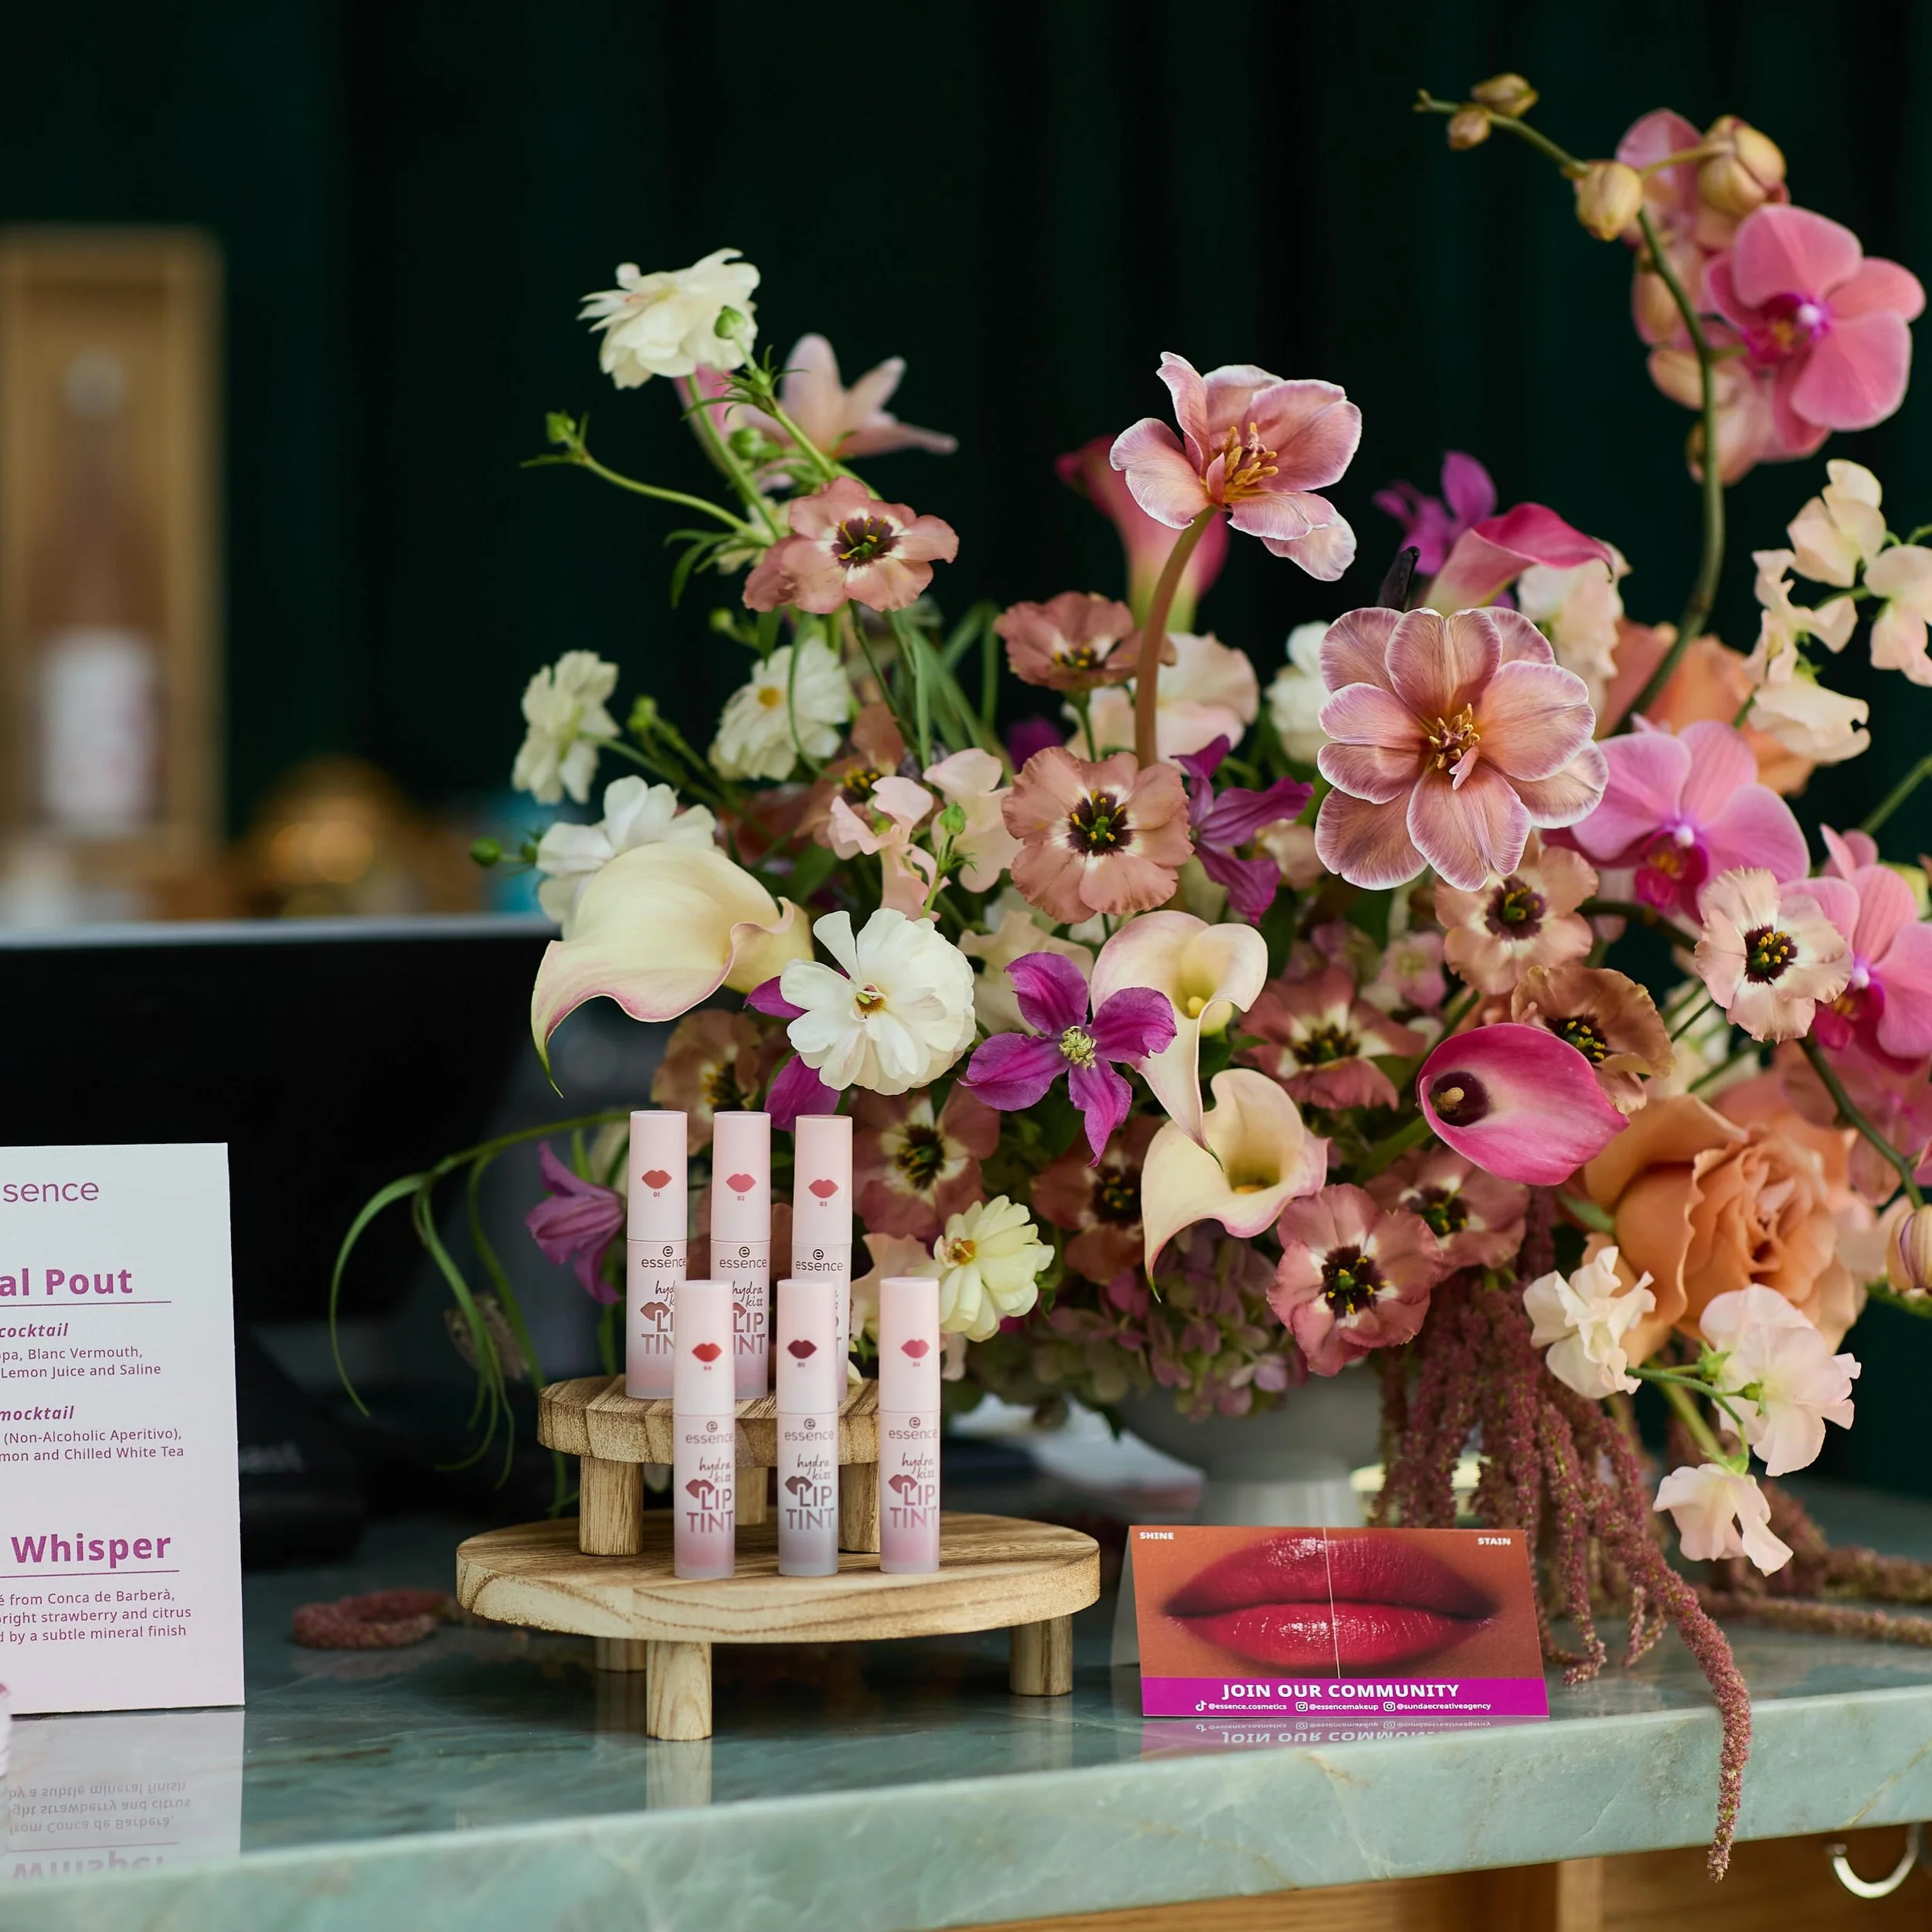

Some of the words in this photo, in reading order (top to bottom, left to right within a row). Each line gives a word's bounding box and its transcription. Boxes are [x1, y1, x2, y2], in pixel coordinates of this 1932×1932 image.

[3, 1182, 99, 1202] sence
[641, 1258, 686, 1268] essence
[719, 1259, 767, 1269] essence
[796, 1260, 843, 1271] essence
[46, 1268, 133, 1295] Pout
[655, 1280, 675, 1301] hyd
[732, 1281, 763, 1302] hydra
[746, 1294, 763, 1308] kiss
[0, 1323, 68, 1338] cocktail
[657, 1311, 673, 1332] LI
[733, 1312, 764, 1333] LIP
[641, 1333, 675, 1355] TIN
[733, 1333, 766, 1355] INT
[0, 1350, 22, 1364] pa,
[29, 1348, 66, 1360] Blanc
[70, 1345, 142, 1359] Vermouth,
[1, 1367, 47, 1379] Lemon
[51, 1366, 85, 1379] Juice
[90, 1364, 115, 1376] and
[120, 1363, 161, 1376] Saline
[4, 1430, 106, 1446] (Non-Alcoholic
[110, 1427, 182, 1444] Aperitivo),
[685, 1433, 733, 1444] essence
[784, 1430, 835, 1441] essence
[889, 1428, 937, 1440] essence
[34, 1449, 60, 1461] and
[64, 1447, 111, 1460] Chilled
[116, 1446, 156, 1459] White
[161, 1445, 184, 1458] Tea
[699, 1456, 731, 1479] hydra
[797, 1453, 830, 1476] hydra
[902, 1452, 934, 1475] hydra
[702, 1488, 733, 1510] LIP
[800, 1485, 832, 1507] LIP
[904, 1485, 935, 1506] LIP
[685, 1510, 733, 1533] TINT
[786, 1508, 835, 1530] TINT
[889, 1505, 937, 1529] TINT
[1139, 1531, 1175, 1540] SHINE
[1477, 1536, 1512, 1546] STAIN
[11, 1532, 171, 1569] Whisper
[9, 1594, 43, 1606] from
[48, 1593, 90, 1604] Conca
[94, 1590, 111, 1603] de
[116, 1588, 175, 1602] Barberà,
[0, 1611, 37, 1627] right
[41, 1610, 117, 1624] strawberry
[122, 1607, 148, 1620] and
[152, 1607, 192, 1618] citrus
[9, 1631, 26, 1645] by
[30, 1632, 37, 1641] a
[43, 1628, 85, 1641] subtle
[90, 1626, 143, 1639] mineral
[148, 1624, 186, 1637] finish
[1221, 1684, 1270, 1700] JOIN
[1277, 1684, 1323, 1698] OUR
[1328, 1684, 1460, 1698] COMMUNITY
